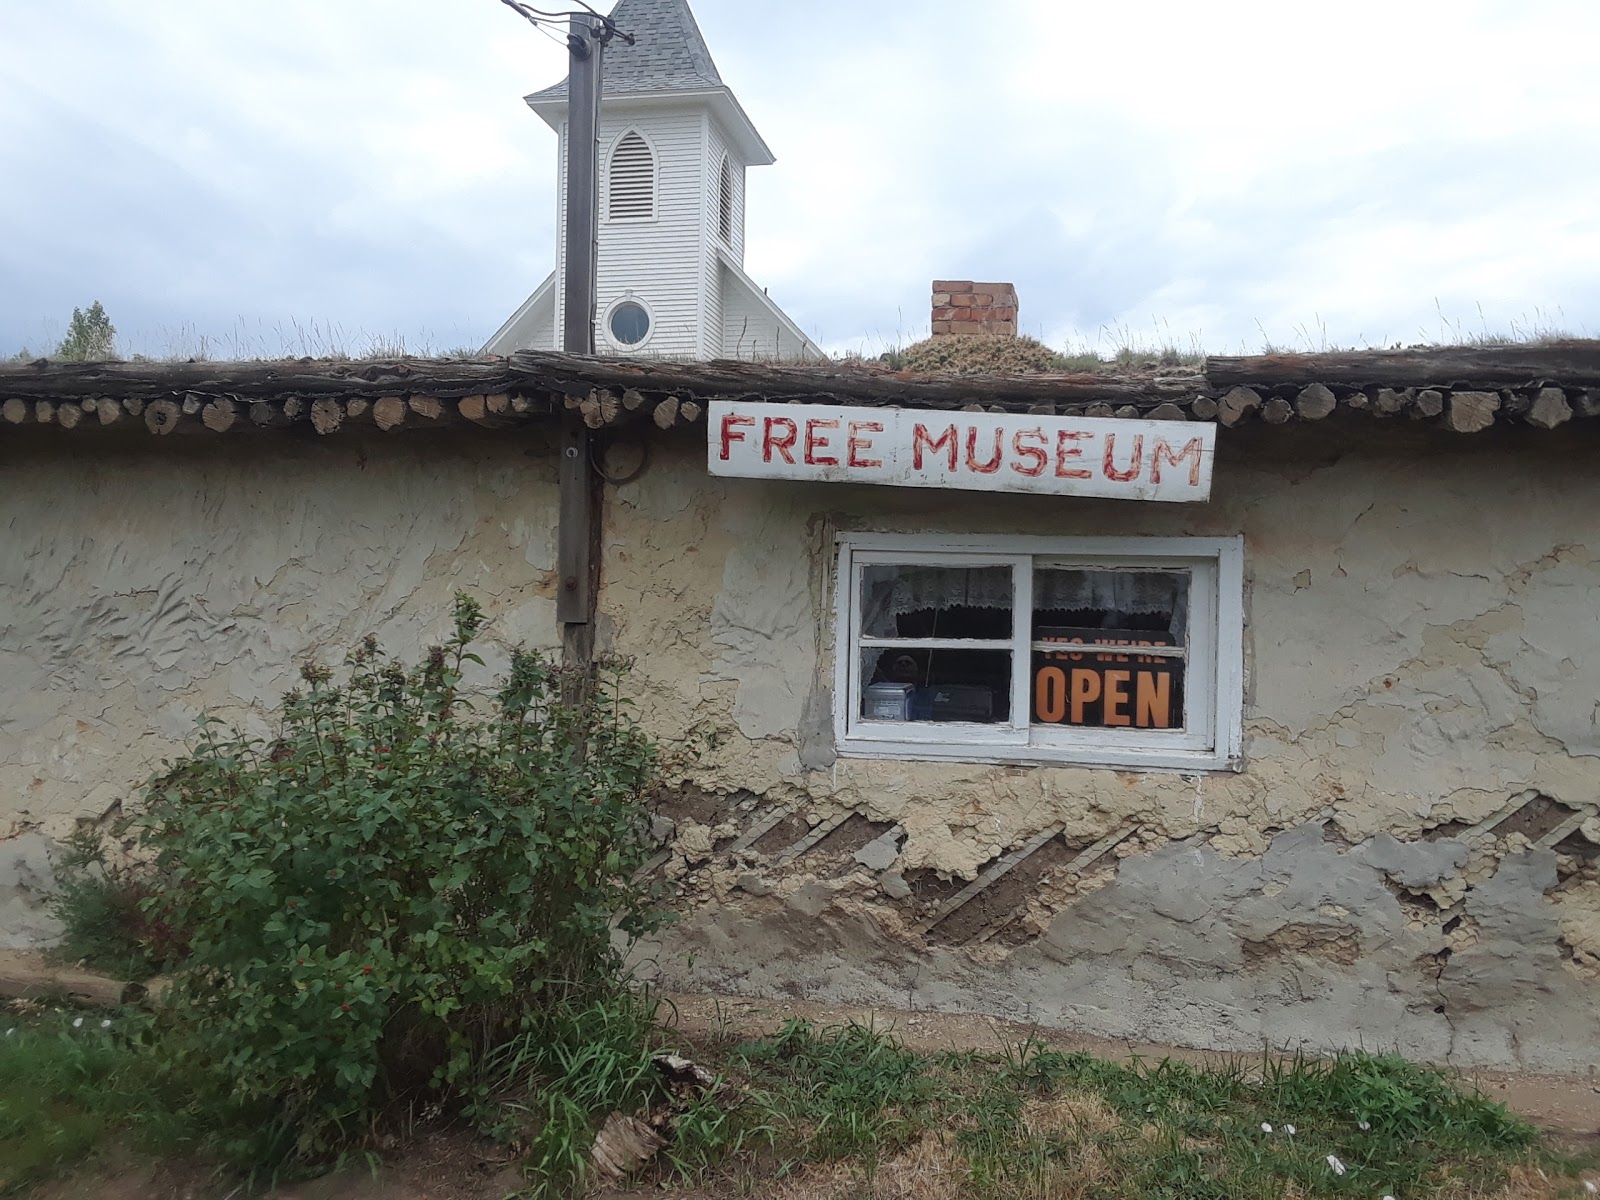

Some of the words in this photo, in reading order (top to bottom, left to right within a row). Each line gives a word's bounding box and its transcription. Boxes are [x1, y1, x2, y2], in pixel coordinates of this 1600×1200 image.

[719, 412, 885, 468] FREE
[912, 423, 1204, 486] MUSEUM
[1036, 666, 1170, 728] OPEN
